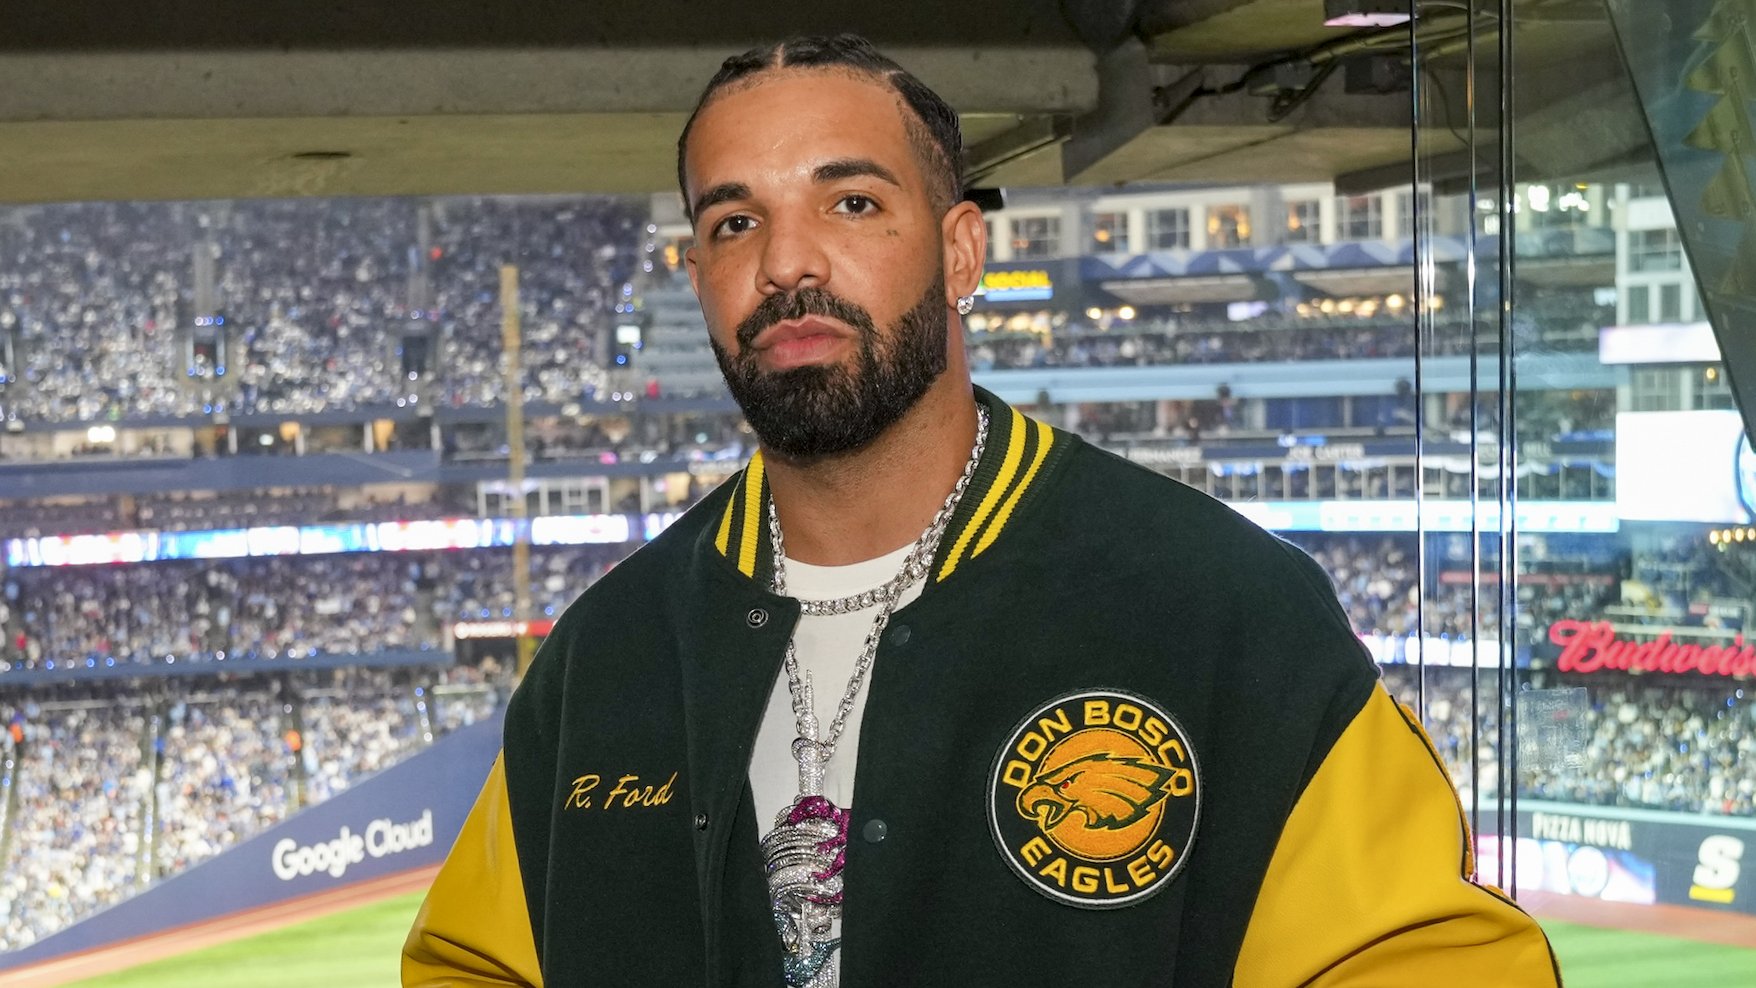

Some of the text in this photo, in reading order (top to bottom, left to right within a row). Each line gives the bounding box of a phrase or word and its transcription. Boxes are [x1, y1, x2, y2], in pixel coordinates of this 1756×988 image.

[1549, 619, 1756, 675] Budweis
[1003, 700, 1194, 797] DON BOSCO
[564, 771, 678, 811] R. Ford
[272, 809, 433, 881] Google Cloud
[1532, 811, 1632, 850] PIZZA NOVA
[1020, 836, 1175, 894] EAGLES
